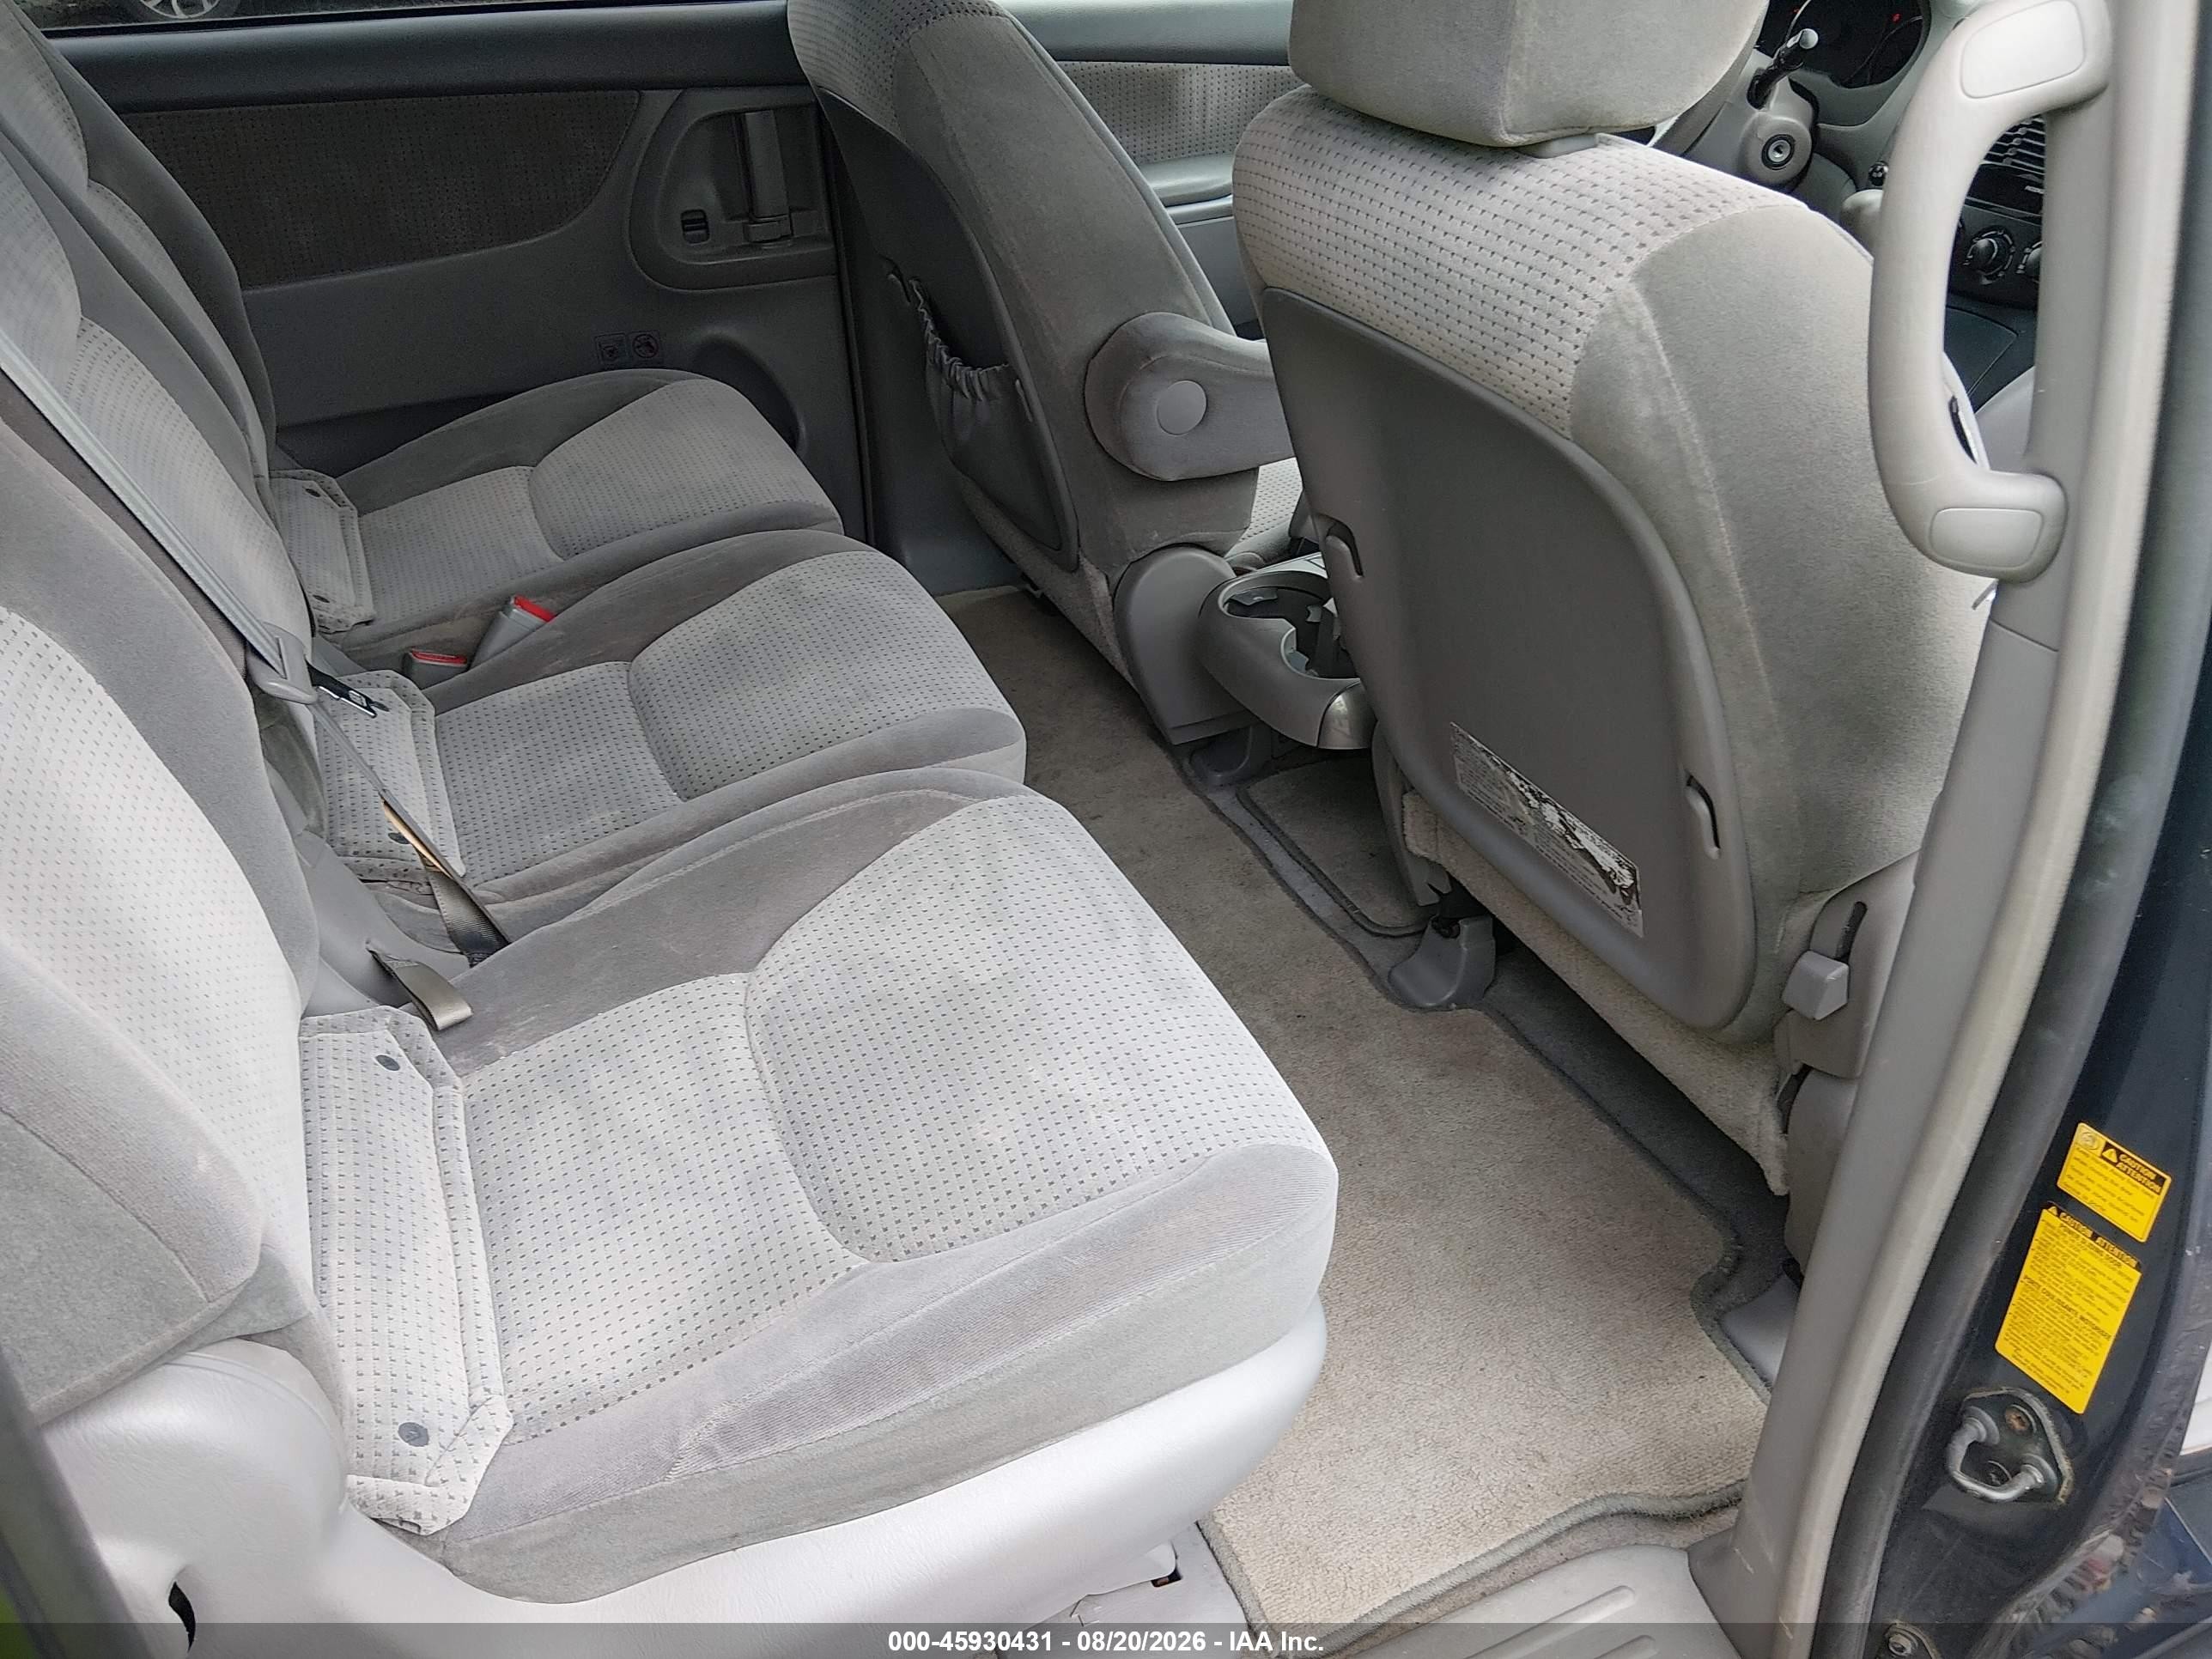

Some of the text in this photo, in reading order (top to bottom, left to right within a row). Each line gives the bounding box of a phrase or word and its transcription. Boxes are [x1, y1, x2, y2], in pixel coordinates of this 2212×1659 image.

[2116, 1162, 2161, 1193] ATTENTION
[2118, 1153, 2156, 1181] CAUTION
[2060, 1212, 2137, 1267] CAUTION ATTENTION
